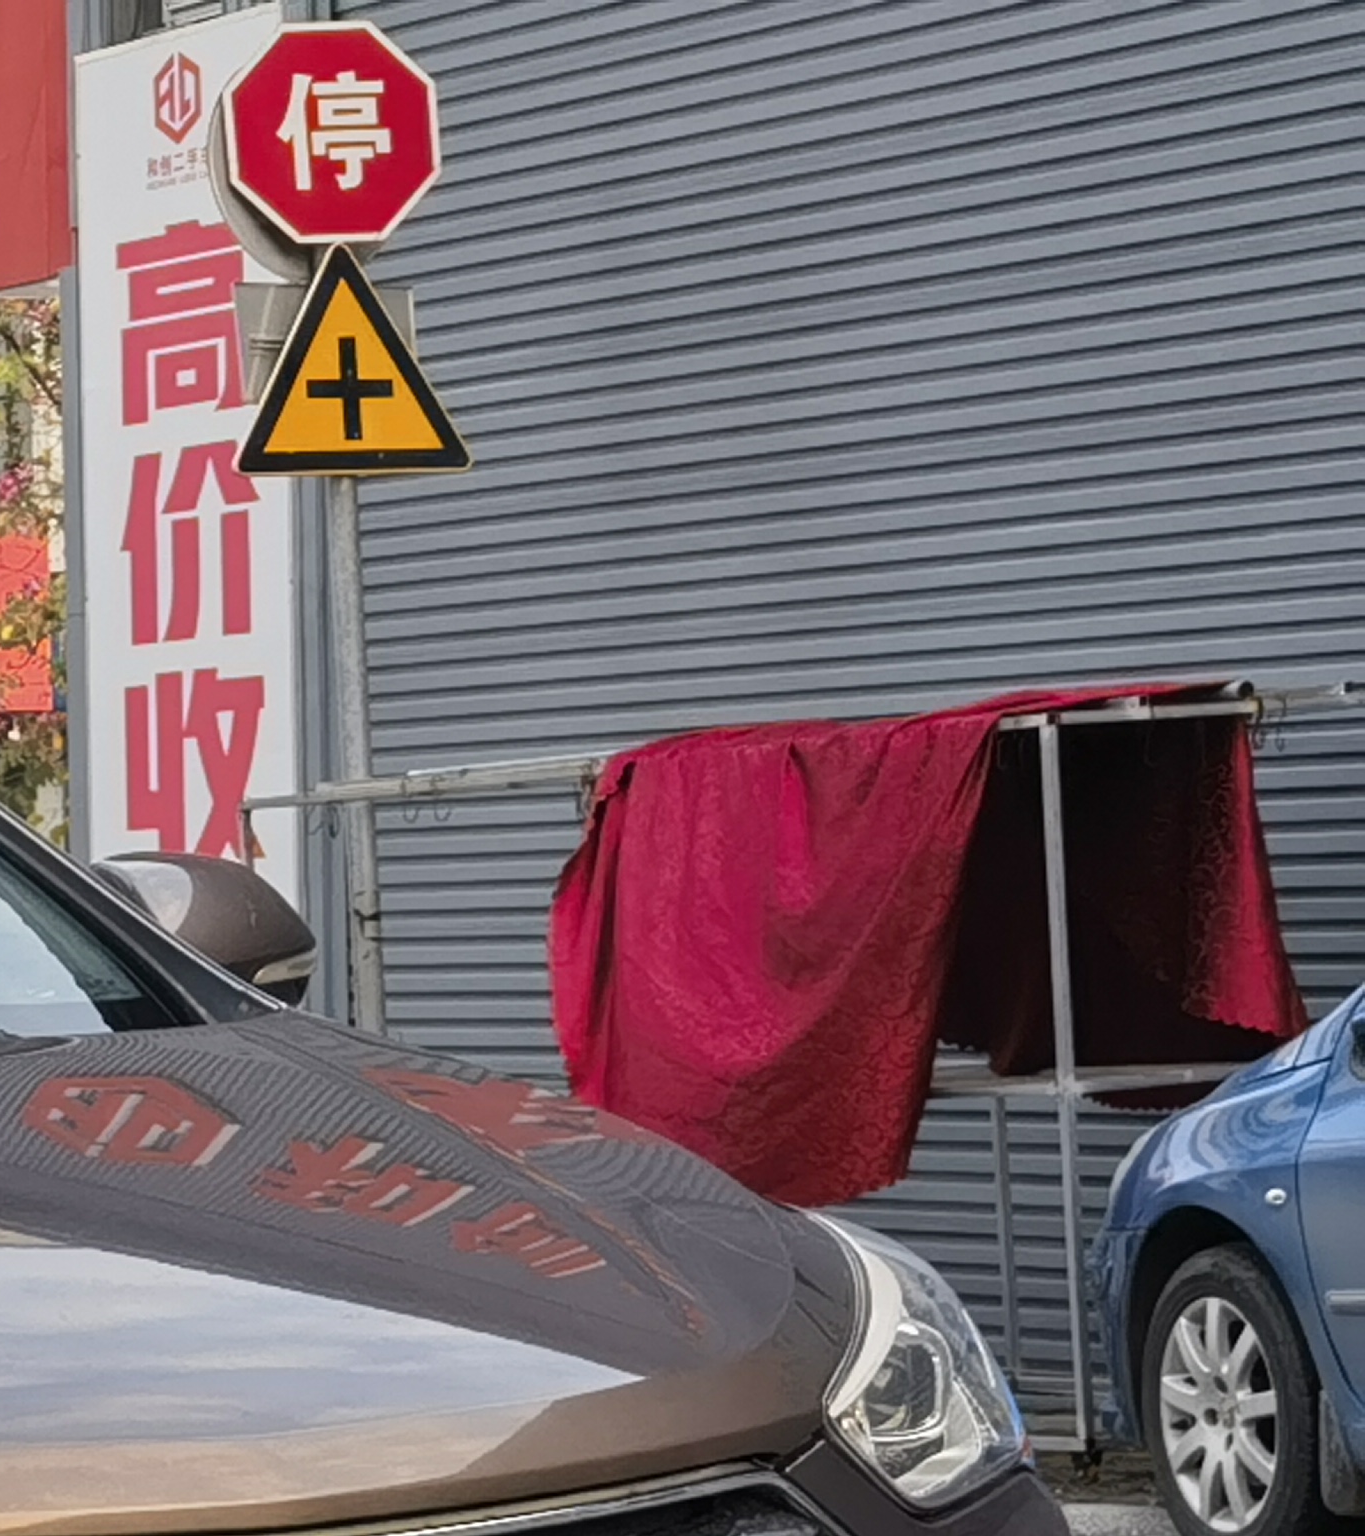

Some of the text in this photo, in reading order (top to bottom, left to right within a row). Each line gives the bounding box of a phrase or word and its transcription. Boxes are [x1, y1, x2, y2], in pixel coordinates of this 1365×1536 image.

[275, 70, 391, 191] 停
[115, 221, 267, 860] 高价收
